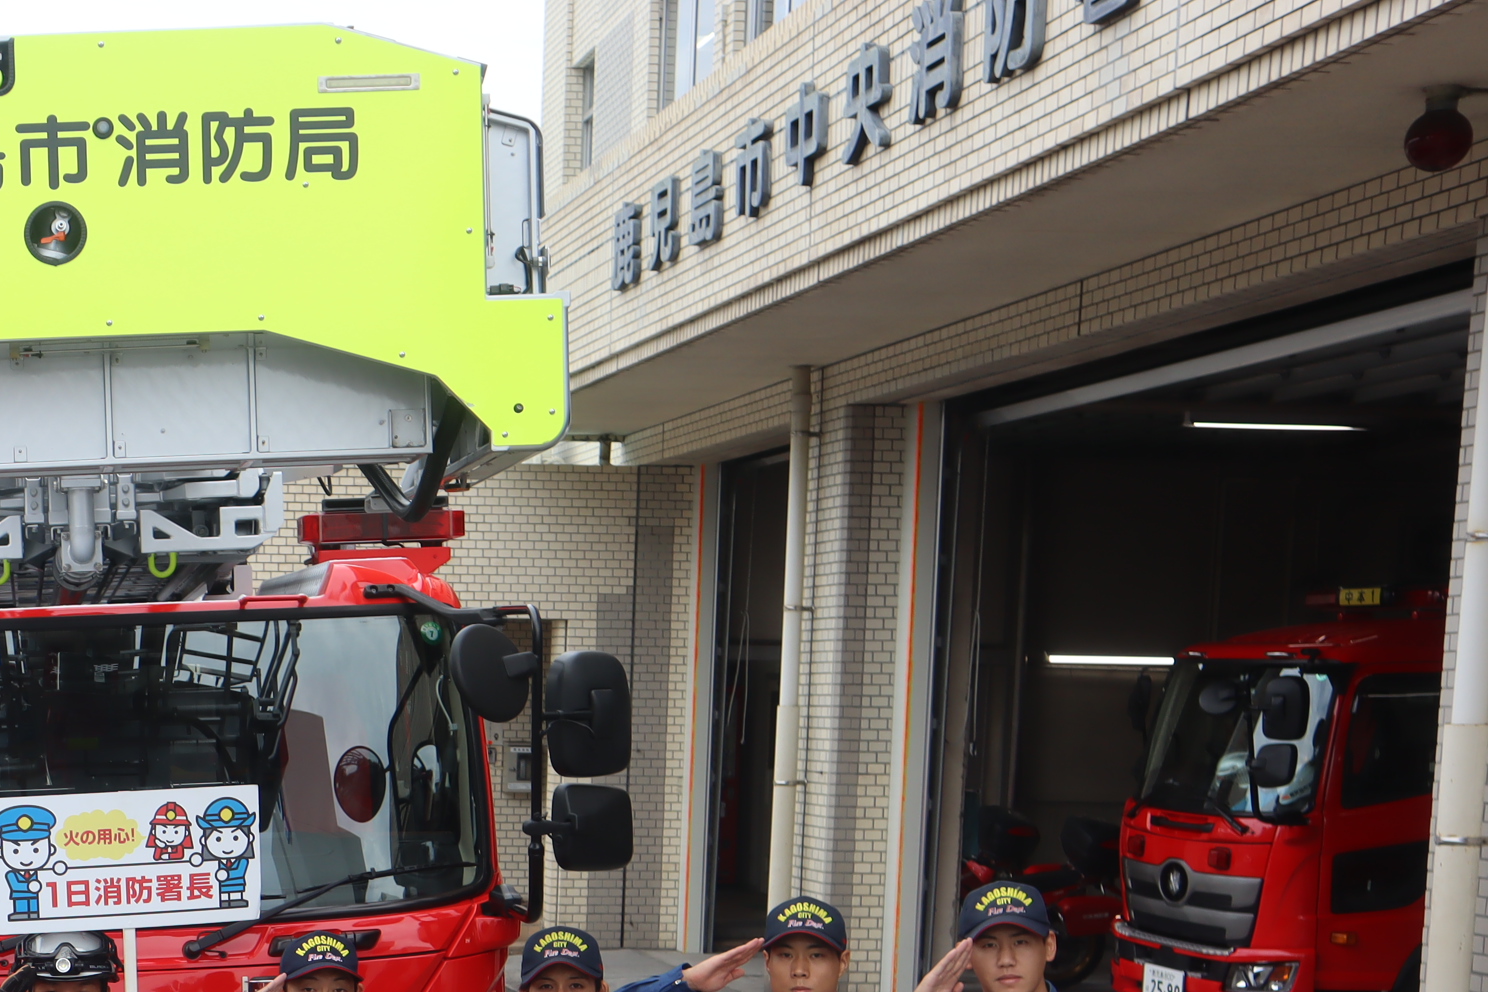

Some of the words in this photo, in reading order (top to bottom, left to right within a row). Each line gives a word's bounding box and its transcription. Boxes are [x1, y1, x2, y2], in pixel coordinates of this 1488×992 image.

[611, 0, 1140, 292] 鹿児島市中央消防
[63, 827, 136, 847] 火の用心!
[45, 871, 215, 908] 1日消防署長
[975, 887, 1033, 911] KAGOSHIMA
[996, 897, 1012, 905] CITY
[777, 902, 833, 924] KAGOSHIMA
[295, 935, 350, 957] KAGOSHIMA
[533, 931, 589, 952] KAGOSHIMA
